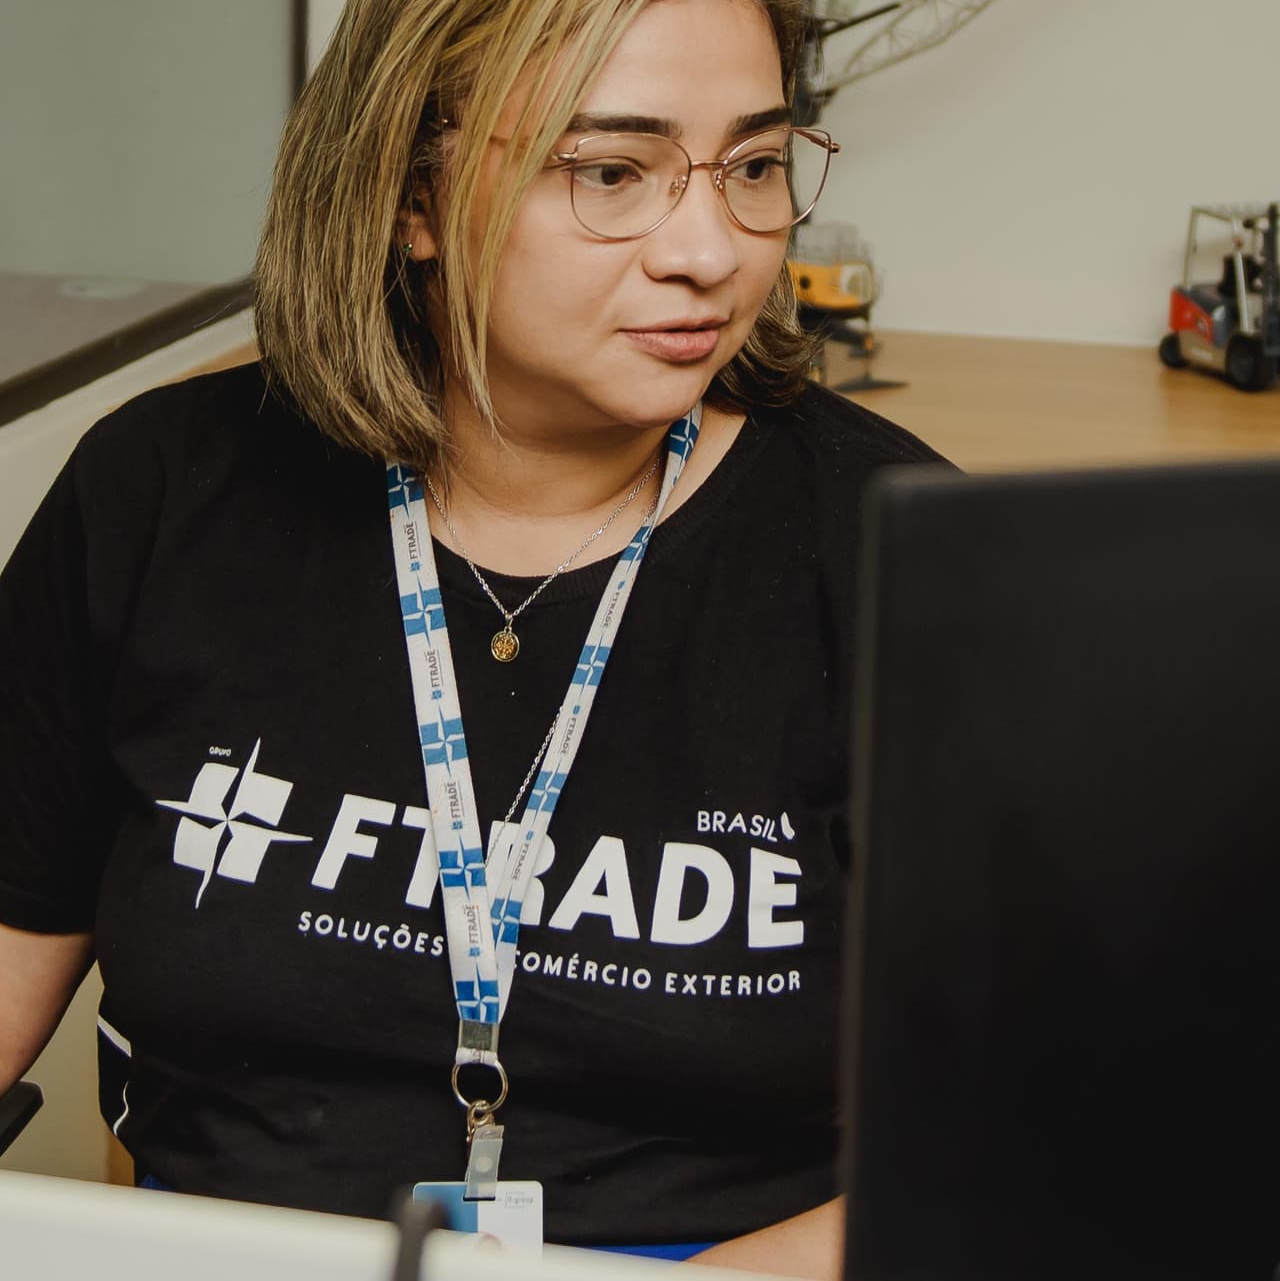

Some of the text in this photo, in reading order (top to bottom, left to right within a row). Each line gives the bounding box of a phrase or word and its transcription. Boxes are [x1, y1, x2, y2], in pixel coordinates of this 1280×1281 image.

[406, 521, 419, 560] FTRADE
[428, 648, 441, 688] FTRADE
[447, 781, 461, 818] FTRADE
[697, 810, 778, 843] BRASIL
[467, 905, 480, 944] FTRADE
[297, 910, 801, 996] SOLUÇÕES OMÉRCIO EXTERIOR
